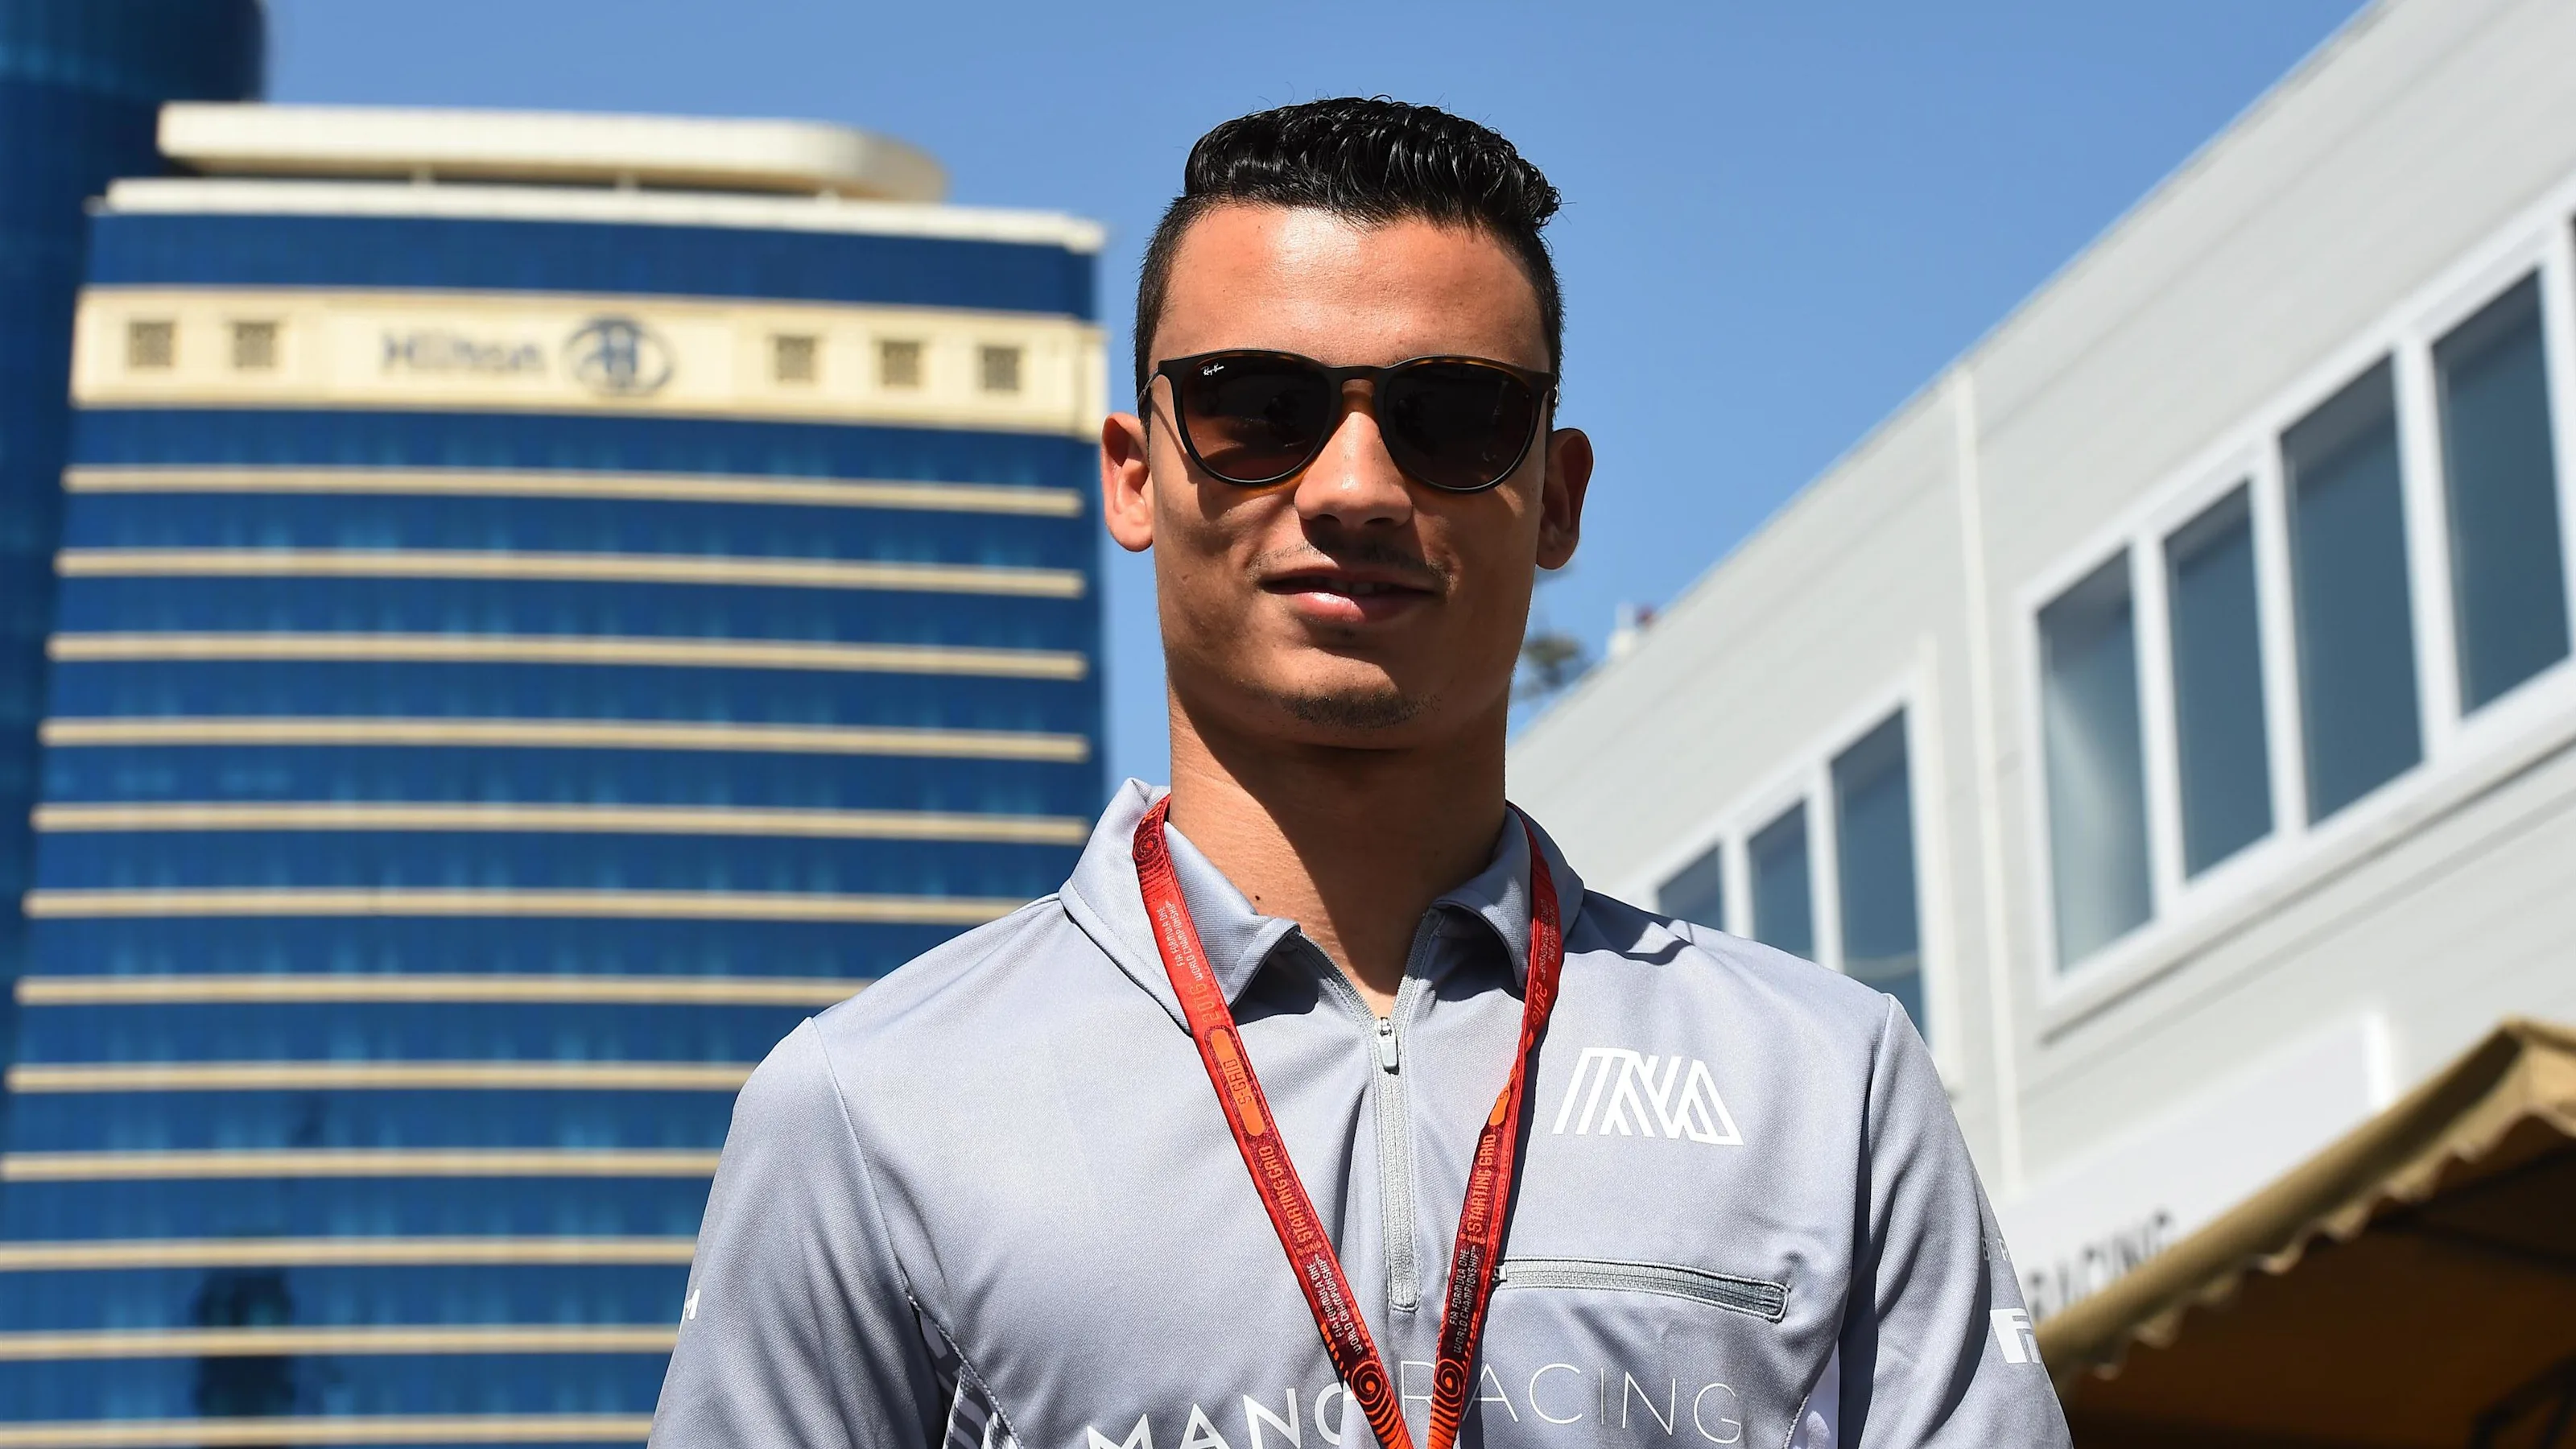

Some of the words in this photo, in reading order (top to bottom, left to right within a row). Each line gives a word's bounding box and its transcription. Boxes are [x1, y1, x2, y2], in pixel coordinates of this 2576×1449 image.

[1162, 922, 1179, 954] FORMULA
[1186, 954, 1203, 981] WORLD
[1190, 983, 1220, 1022] 2016
[1532, 981, 1547, 1025] 2016
[1258, 1145, 1284, 1179] GRID
[1467, 1167, 1491, 1233] STARTING
[1479, 1134, 1496, 1167] GRID
[1273, 1179, 1314, 1243] STARTING
[1307, 1262, 1321, 1281] ONE
[1458, 1248, 1470, 1268] ONE
[1315, 1282, 1338, 1322] FORMULA
[1452, 1269, 1467, 1311] FORMULA
[1332, 1323, 1344, 1338] FIA
[1449, 1311, 1459, 1325] FIA
[1344, 1323, 1363, 1356] WORLD
[1454, 1321, 1468, 1354] WORLD
[1401, 1360, 1740, 1444] RACING
